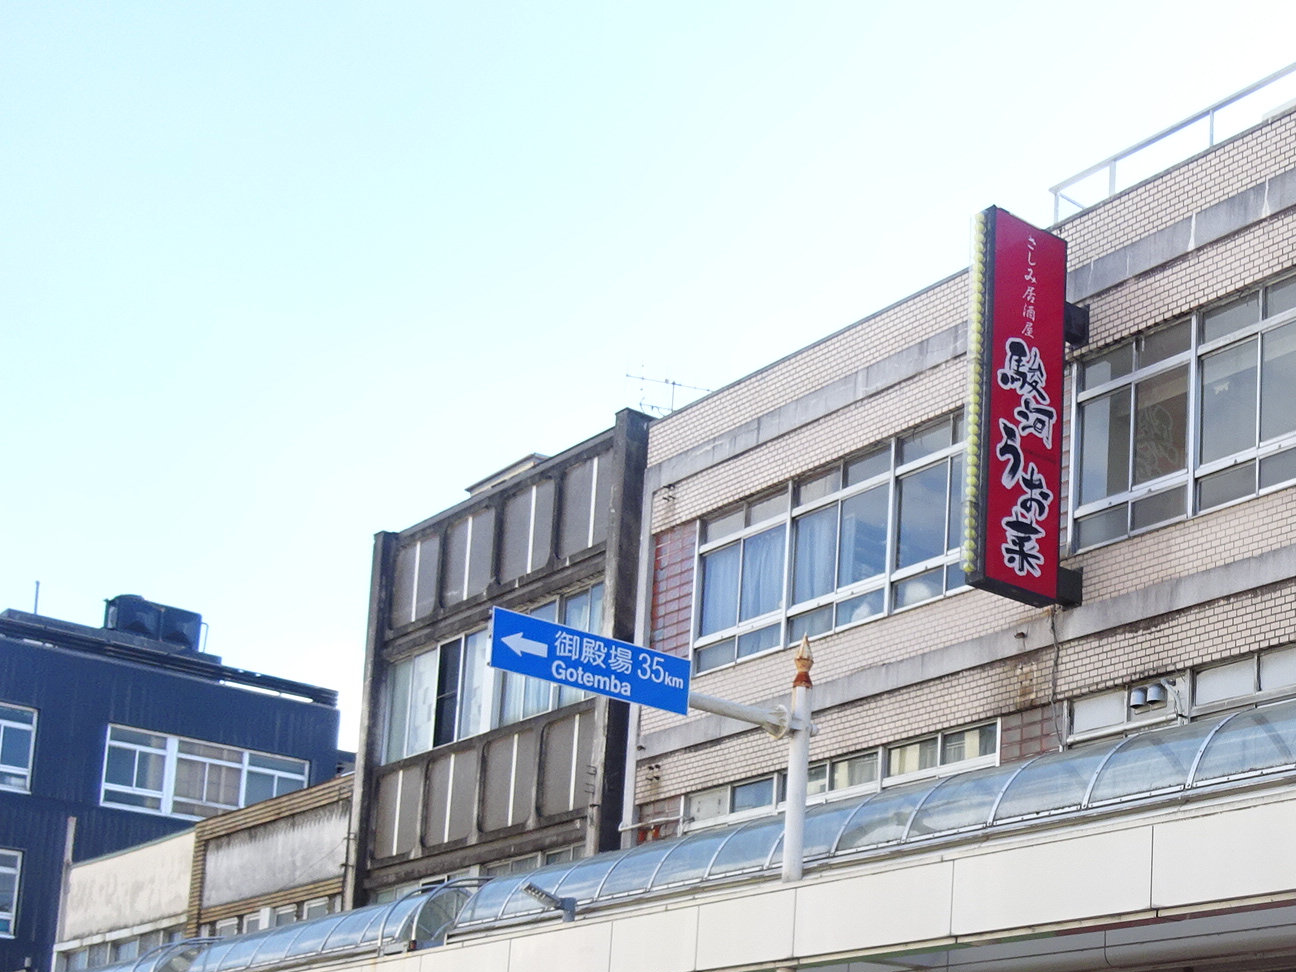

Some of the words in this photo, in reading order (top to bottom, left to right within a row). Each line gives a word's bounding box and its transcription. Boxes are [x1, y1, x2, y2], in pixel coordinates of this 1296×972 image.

[1021, 235, 1038, 340] さしみ居酒屋
[997, 337, 1056, 577] 駿河うお菜
[552, 660, 632, 697] Gotemba
[553, 631, 634, 675] 御殿場
